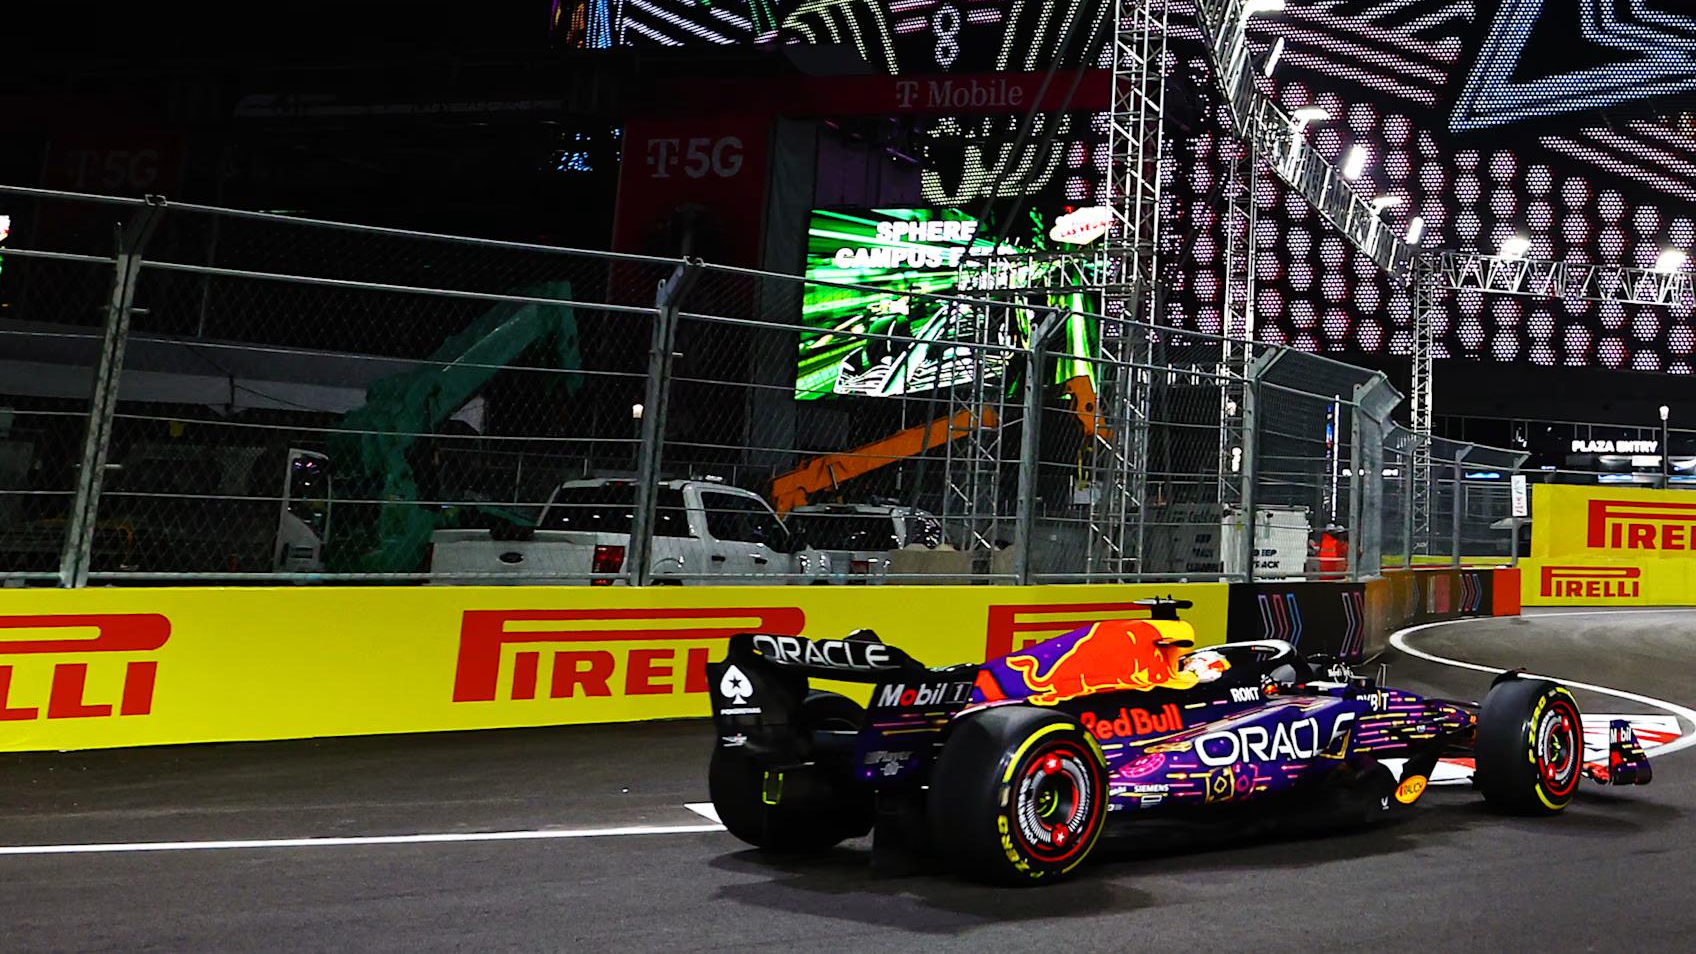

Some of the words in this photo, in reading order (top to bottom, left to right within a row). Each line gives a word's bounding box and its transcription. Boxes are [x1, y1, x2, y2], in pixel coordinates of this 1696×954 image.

[928, 79, 1023, 107] Mobile
[685, 138, 744, 178] 5G
[875, 221, 977, 242] SPHERE
[835, 248, 943, 269] CAMPUS
[1572, 440, 1614, 453] PLAZA
[1616, 440, 1658, 453] ENTRY
[1540, 565, 1640, 598] PIRELLI
[453, 607, 805, 703] PIREL
[753, 635, 889, 669] ORACLE
[877, 683, 948, 707] Mobil
[1230, 687, 1259, 702] ROKT
[1080, 709, 1132, 740] Red
[1130, 701, 1184, 736] Bull
